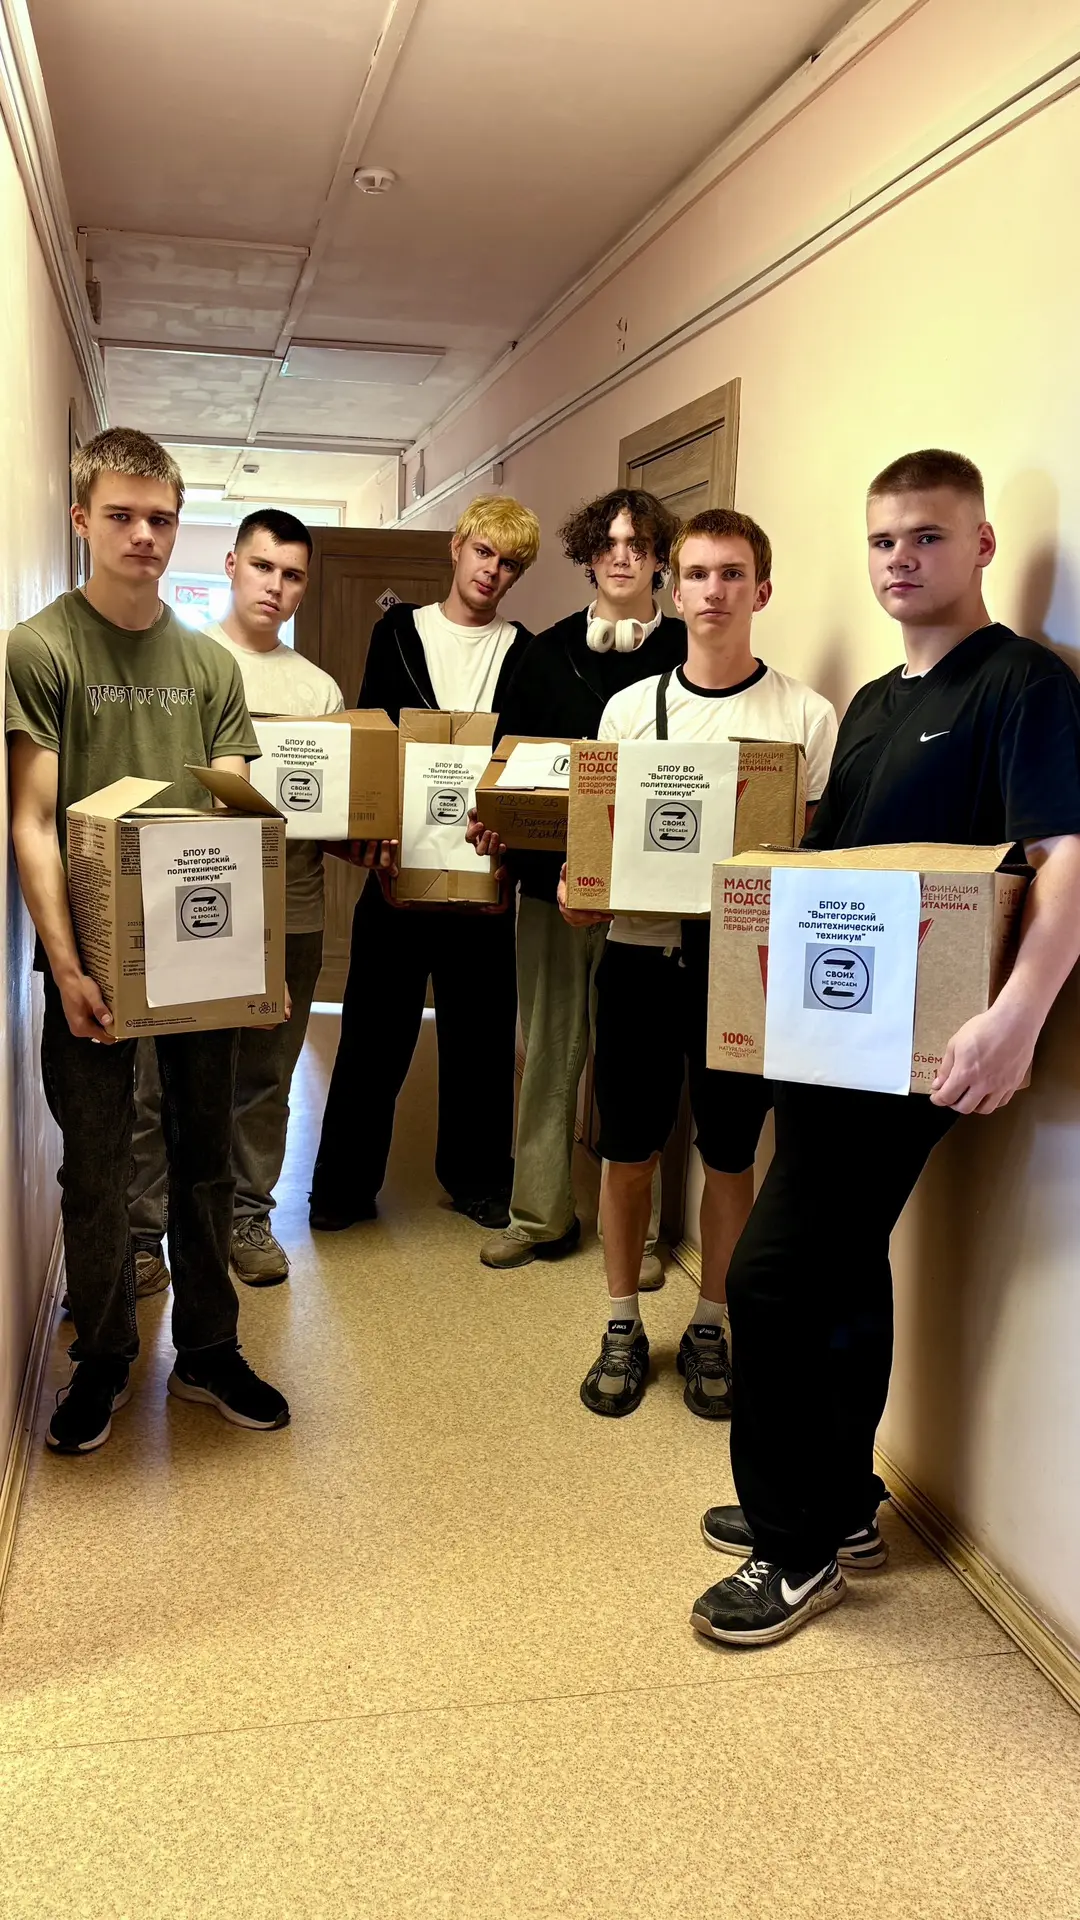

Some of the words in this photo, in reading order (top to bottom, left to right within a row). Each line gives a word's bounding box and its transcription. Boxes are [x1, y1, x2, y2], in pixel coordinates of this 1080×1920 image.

[382, 596, 396, 606] 49
[277, 745, 324, 754] "Вытегорский
[648, 773, 704, 782] "Вытегорский
[654, 790, 696, 798] техникум"
[183, 849, 206, 857] БПОУ
[174, 855, 230, 866] "Вытегорский
[167, 863, 237, 875] политехнический
[182, 873, 223, 882] техникум"
[577, 876, 605, 887] 100%
[924, 885, 978, 894] АФИНАЦИЯ
[922, 893, 962, 901] НЕНИЕМ
[819, 901, 847, 910] БПОУ
[850, 902, 865, 910] ВО
[922, 902, 970, 910] ИТАМИНА
[808, 910, 876, 922] "Вытегорский
[798, 921, 885, 932] политехнический
[816, 932, 866, 942] техникум"
[825, 971, 854, 979] СВОИХ
[722, 1032, 754, 1046] 100%
[914, 1052, 942, 1064] бъём
